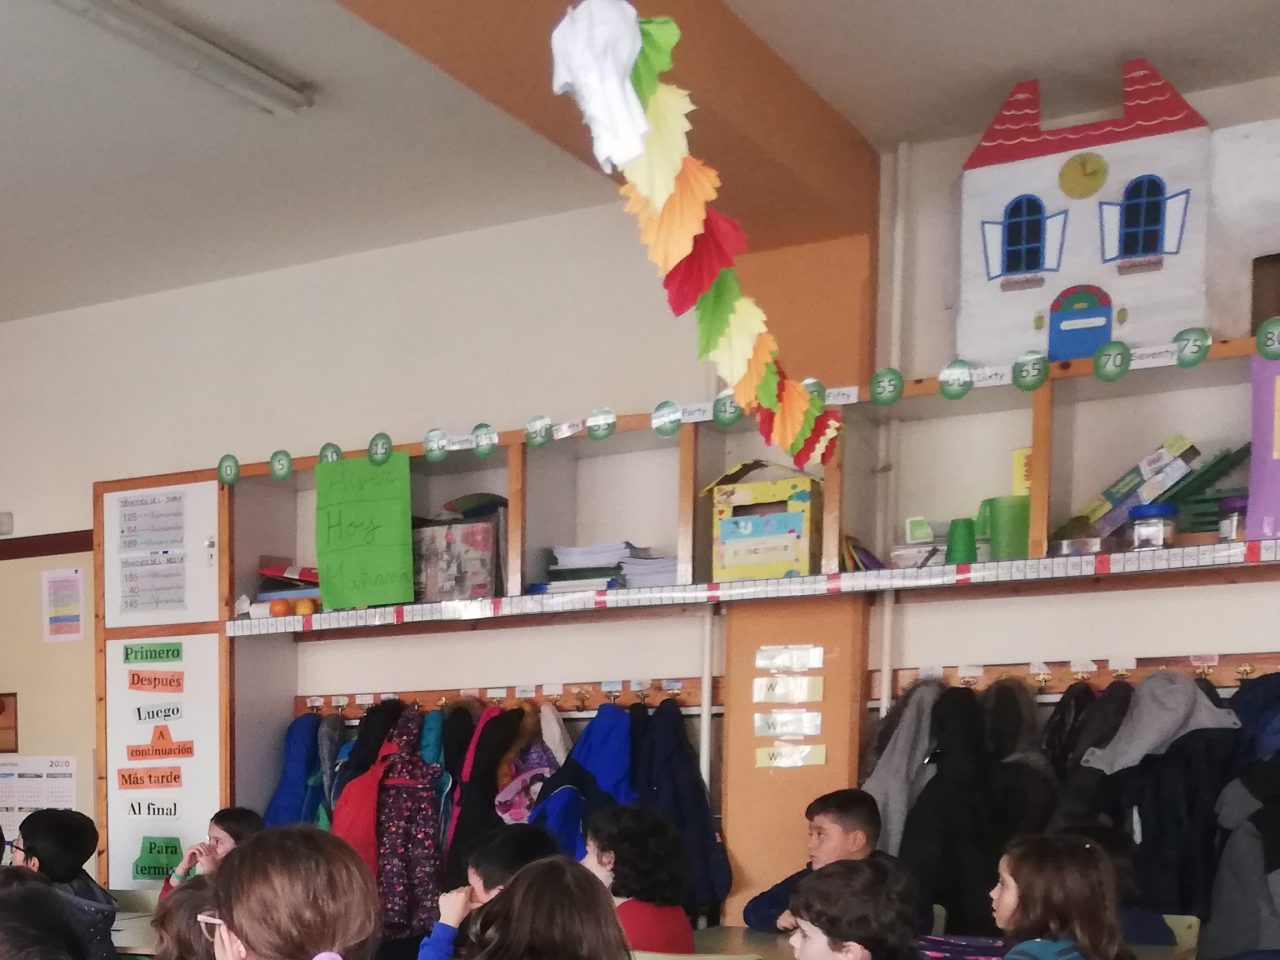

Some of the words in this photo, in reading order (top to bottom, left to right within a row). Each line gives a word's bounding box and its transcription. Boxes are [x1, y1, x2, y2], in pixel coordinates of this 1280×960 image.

[1181, 338, 1202, 354] 75
[1102, 353, 1123, 369] 70
[1020, 362, 1042, 379] 65
[876, 379, 897, 395] 55
[720, 401, 737, 415] 45
[372, 441, 388, 456] 15
[225, 464, 233, 477] 0
[277, 458, 285, 471] 5
[327, 510, 383, 545] Hoy
[124, 646, 181, 661] Primero
[131, 673, 181, 690] Después
[136, 706, 180, 721] Luego
[158, 730, 165, 740] A
[130, 744, 193, 757] continuación
[49, 760, 70, 768] 2020
[121, 772, 144, 786] Más
[148, 770, 181, 785] tarde
[128, 802, 141, 816] Al
[146, 802, 177, 816] final
[148, 842, 178, 855] Para
